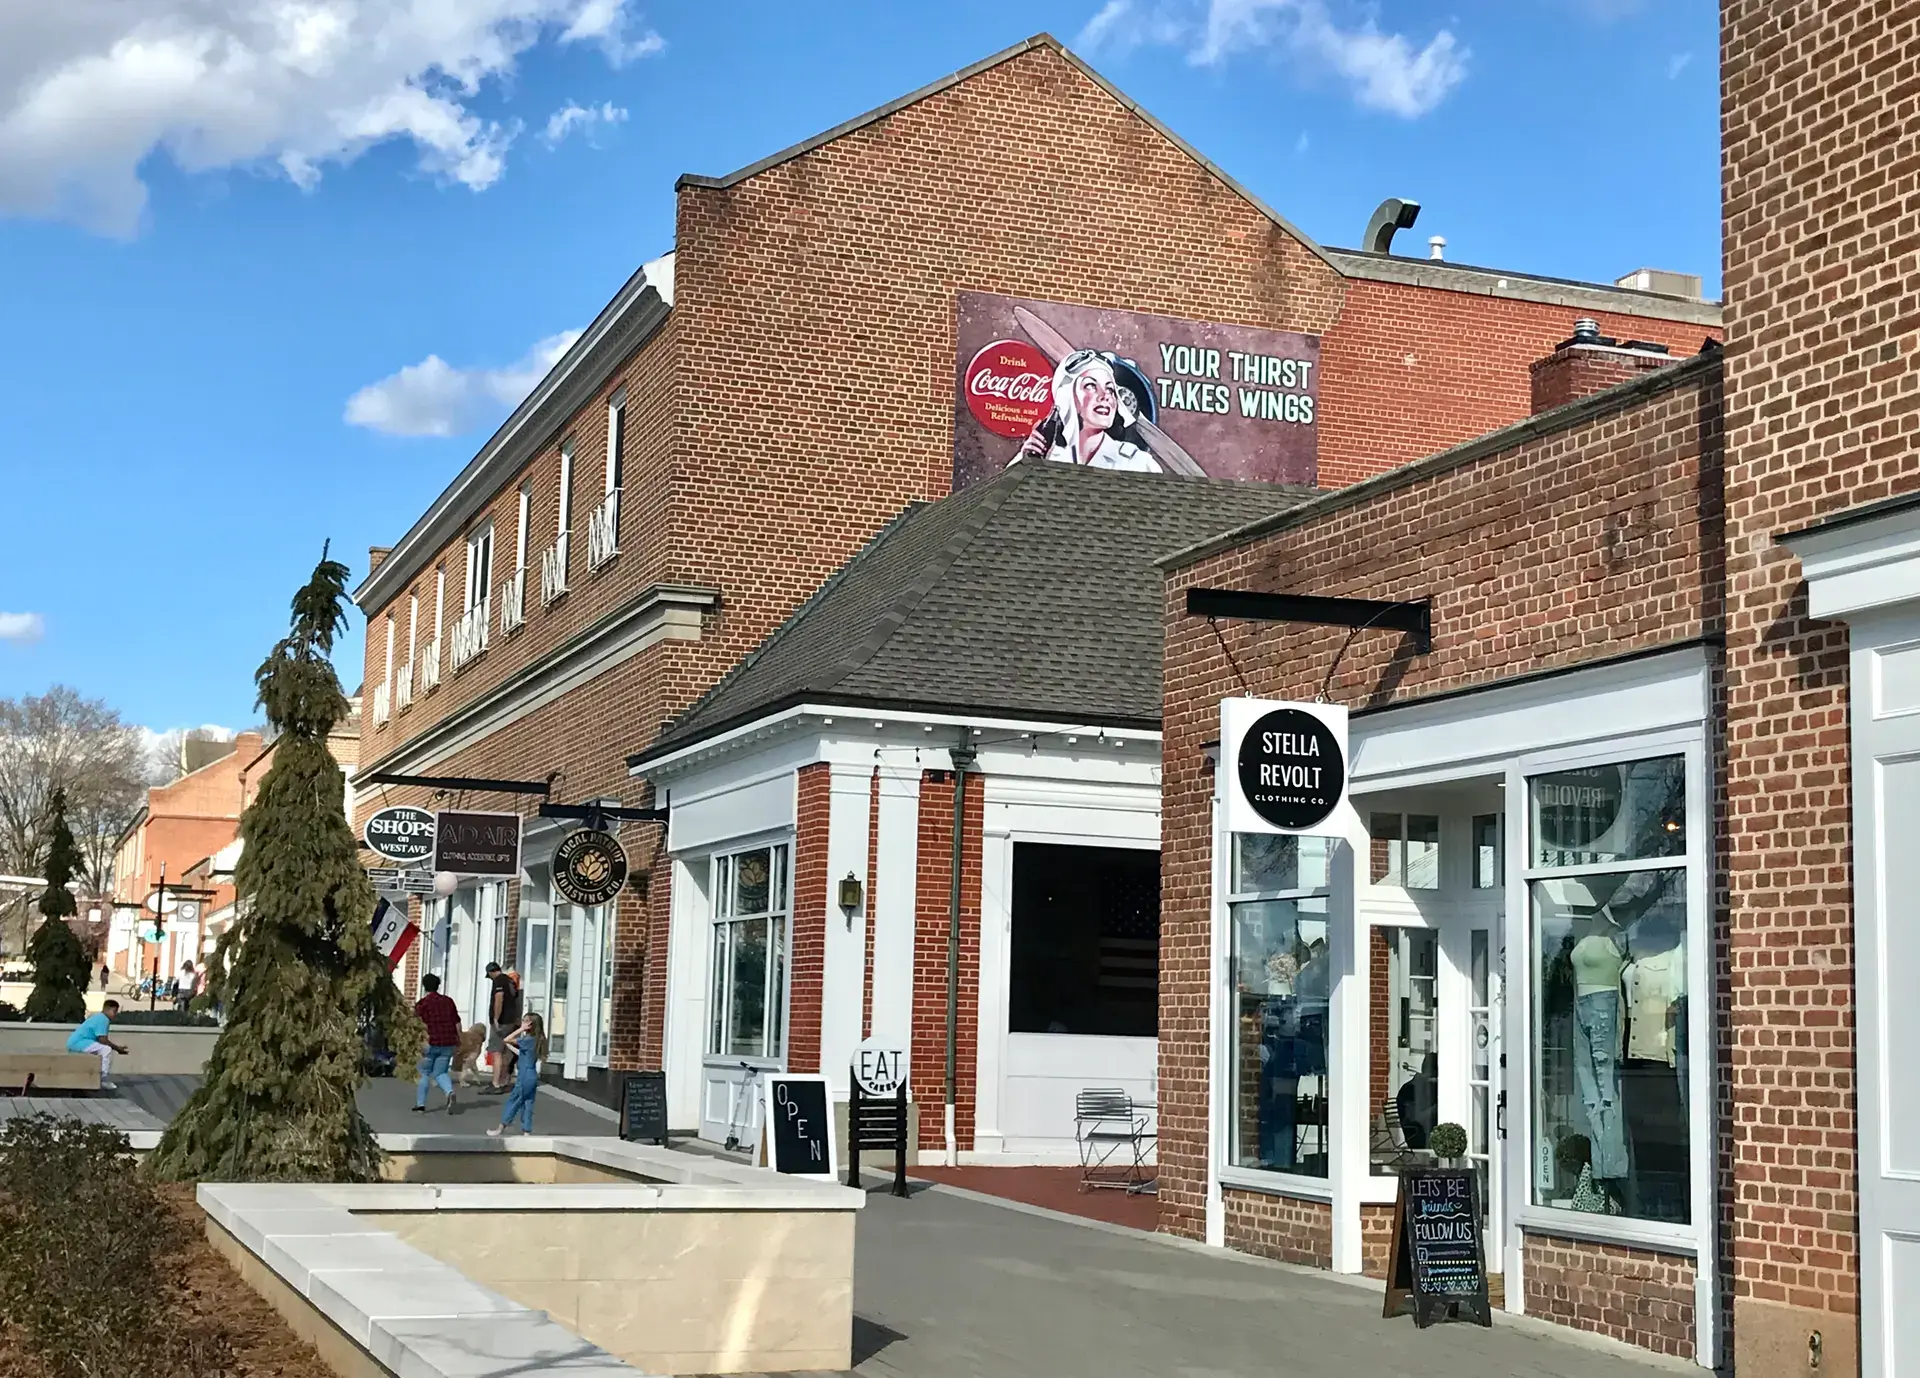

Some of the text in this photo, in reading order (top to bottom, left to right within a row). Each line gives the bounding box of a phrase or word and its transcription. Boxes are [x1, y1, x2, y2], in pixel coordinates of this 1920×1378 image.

[1000, 355, 1027, 368] Drink
[1159, 343, 1313, 390] YOUR THIRST
[970, 367, 1053, 404] Coca-Cola
[985, 402, 1039, 416] Delicious and
[1157, 377, 1314, 425] TAKES WINGS
[991, 411, 1033, 426] Refreshing
[1262, 731, 1320, 757] STELLA
[1260, 763, 1322, 789] REVOLT
[1254, 794, 1328, 805] CLOTHING CO.
[394, 810, 417, 820] THE
[371, 818, 435, 837] SHOPS
[439, 823, 517, 847] ADAIR
[380, 843, 428, 854] WEST AVE
[559, 833, 588, 859] LOCAL
[556, 871, 623, 903] ROASTING CO.
[861, 1051, 902, 1081] EAT
[868, 1080, 897, 1092] CAKES
[777, 1084, 821, 1161] OPEN
[1412, 1179, 1441, 1197] LETS
[1421, 1199, 1454, 1220] friends
[1415, 1222, 1472, 1240] FOLLOW US
